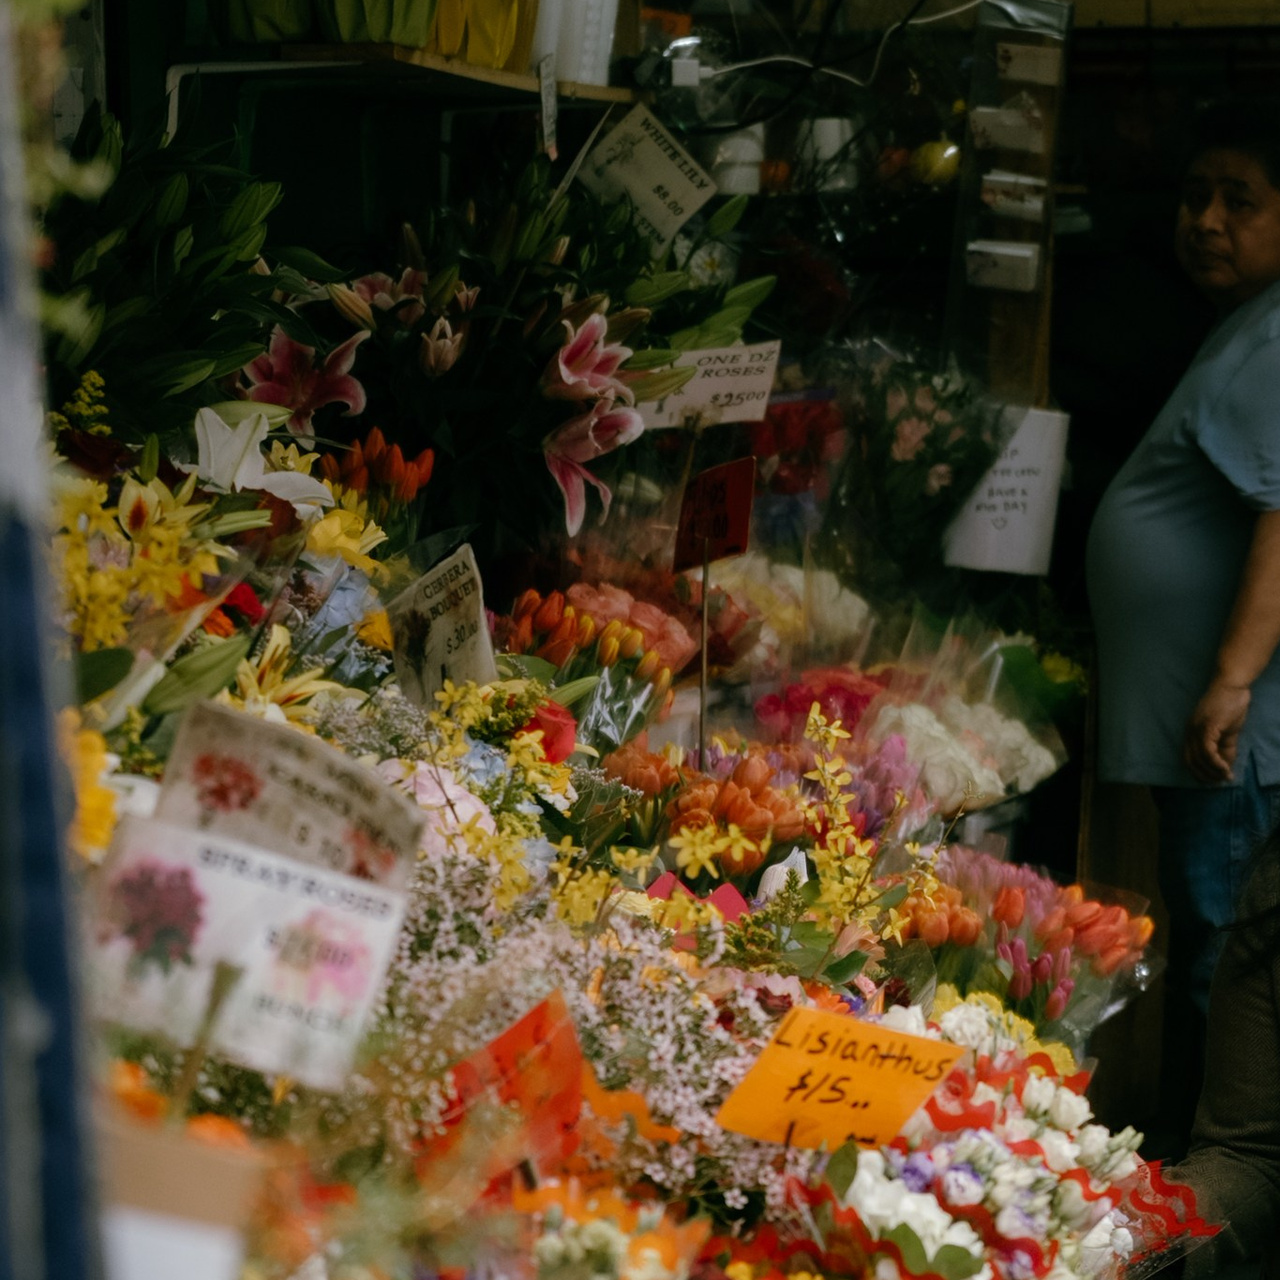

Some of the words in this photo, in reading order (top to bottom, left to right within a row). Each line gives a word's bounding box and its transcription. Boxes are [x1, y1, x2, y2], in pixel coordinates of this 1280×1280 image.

[640, 117, 681, 162] WHITE
[677, 159, 709, 190] LILY
[652, 184, 684, 216] $8.00
[697, 354, 742, 367] ONE
[701, 366, 766, 379] ROSES
[429, 576, 479, 620] BOUQUET
[774, 1009, 953, 1082] Lisianthus
